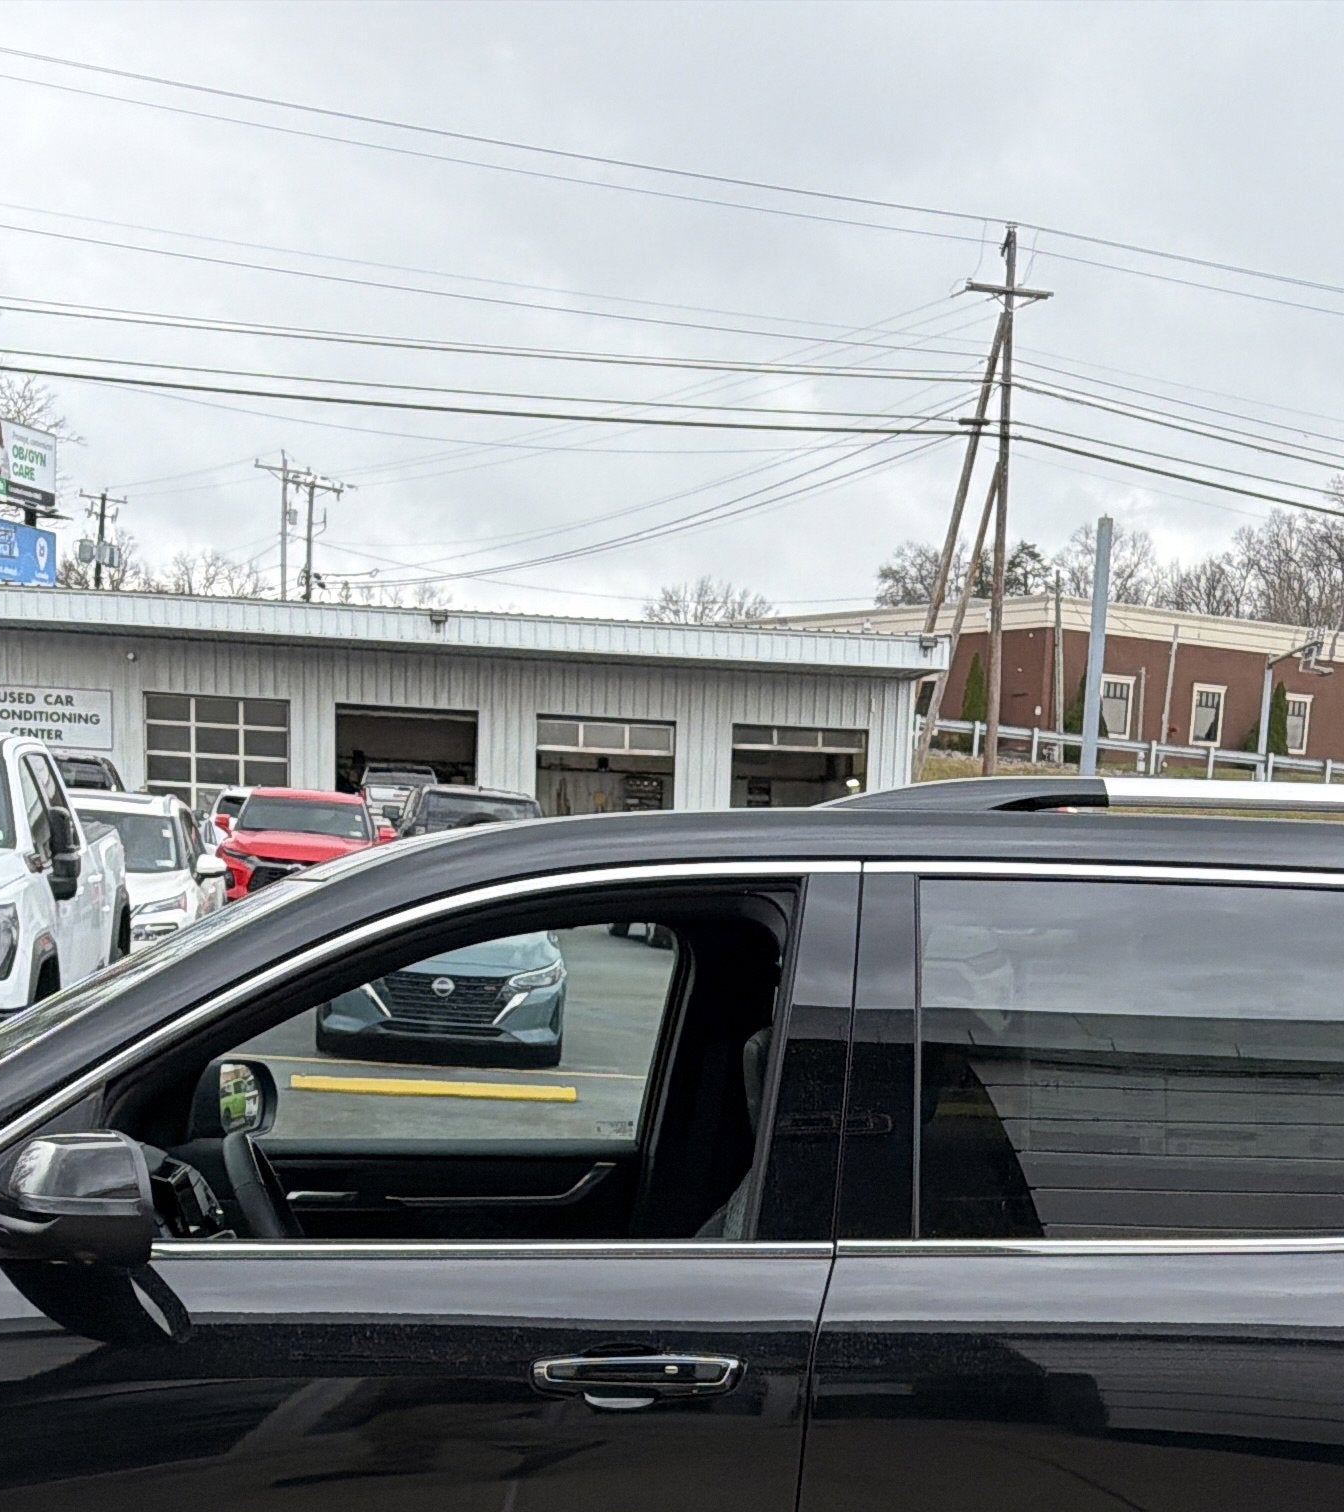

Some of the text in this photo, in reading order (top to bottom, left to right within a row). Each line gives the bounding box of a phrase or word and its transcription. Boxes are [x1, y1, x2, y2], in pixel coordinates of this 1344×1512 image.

[11, 443, 47, 468] OB/GYN
[11, 461, 36, 482] CARE
[43, 692, 75, 708] CAR
[10, 726, 64, 740] CENTER
